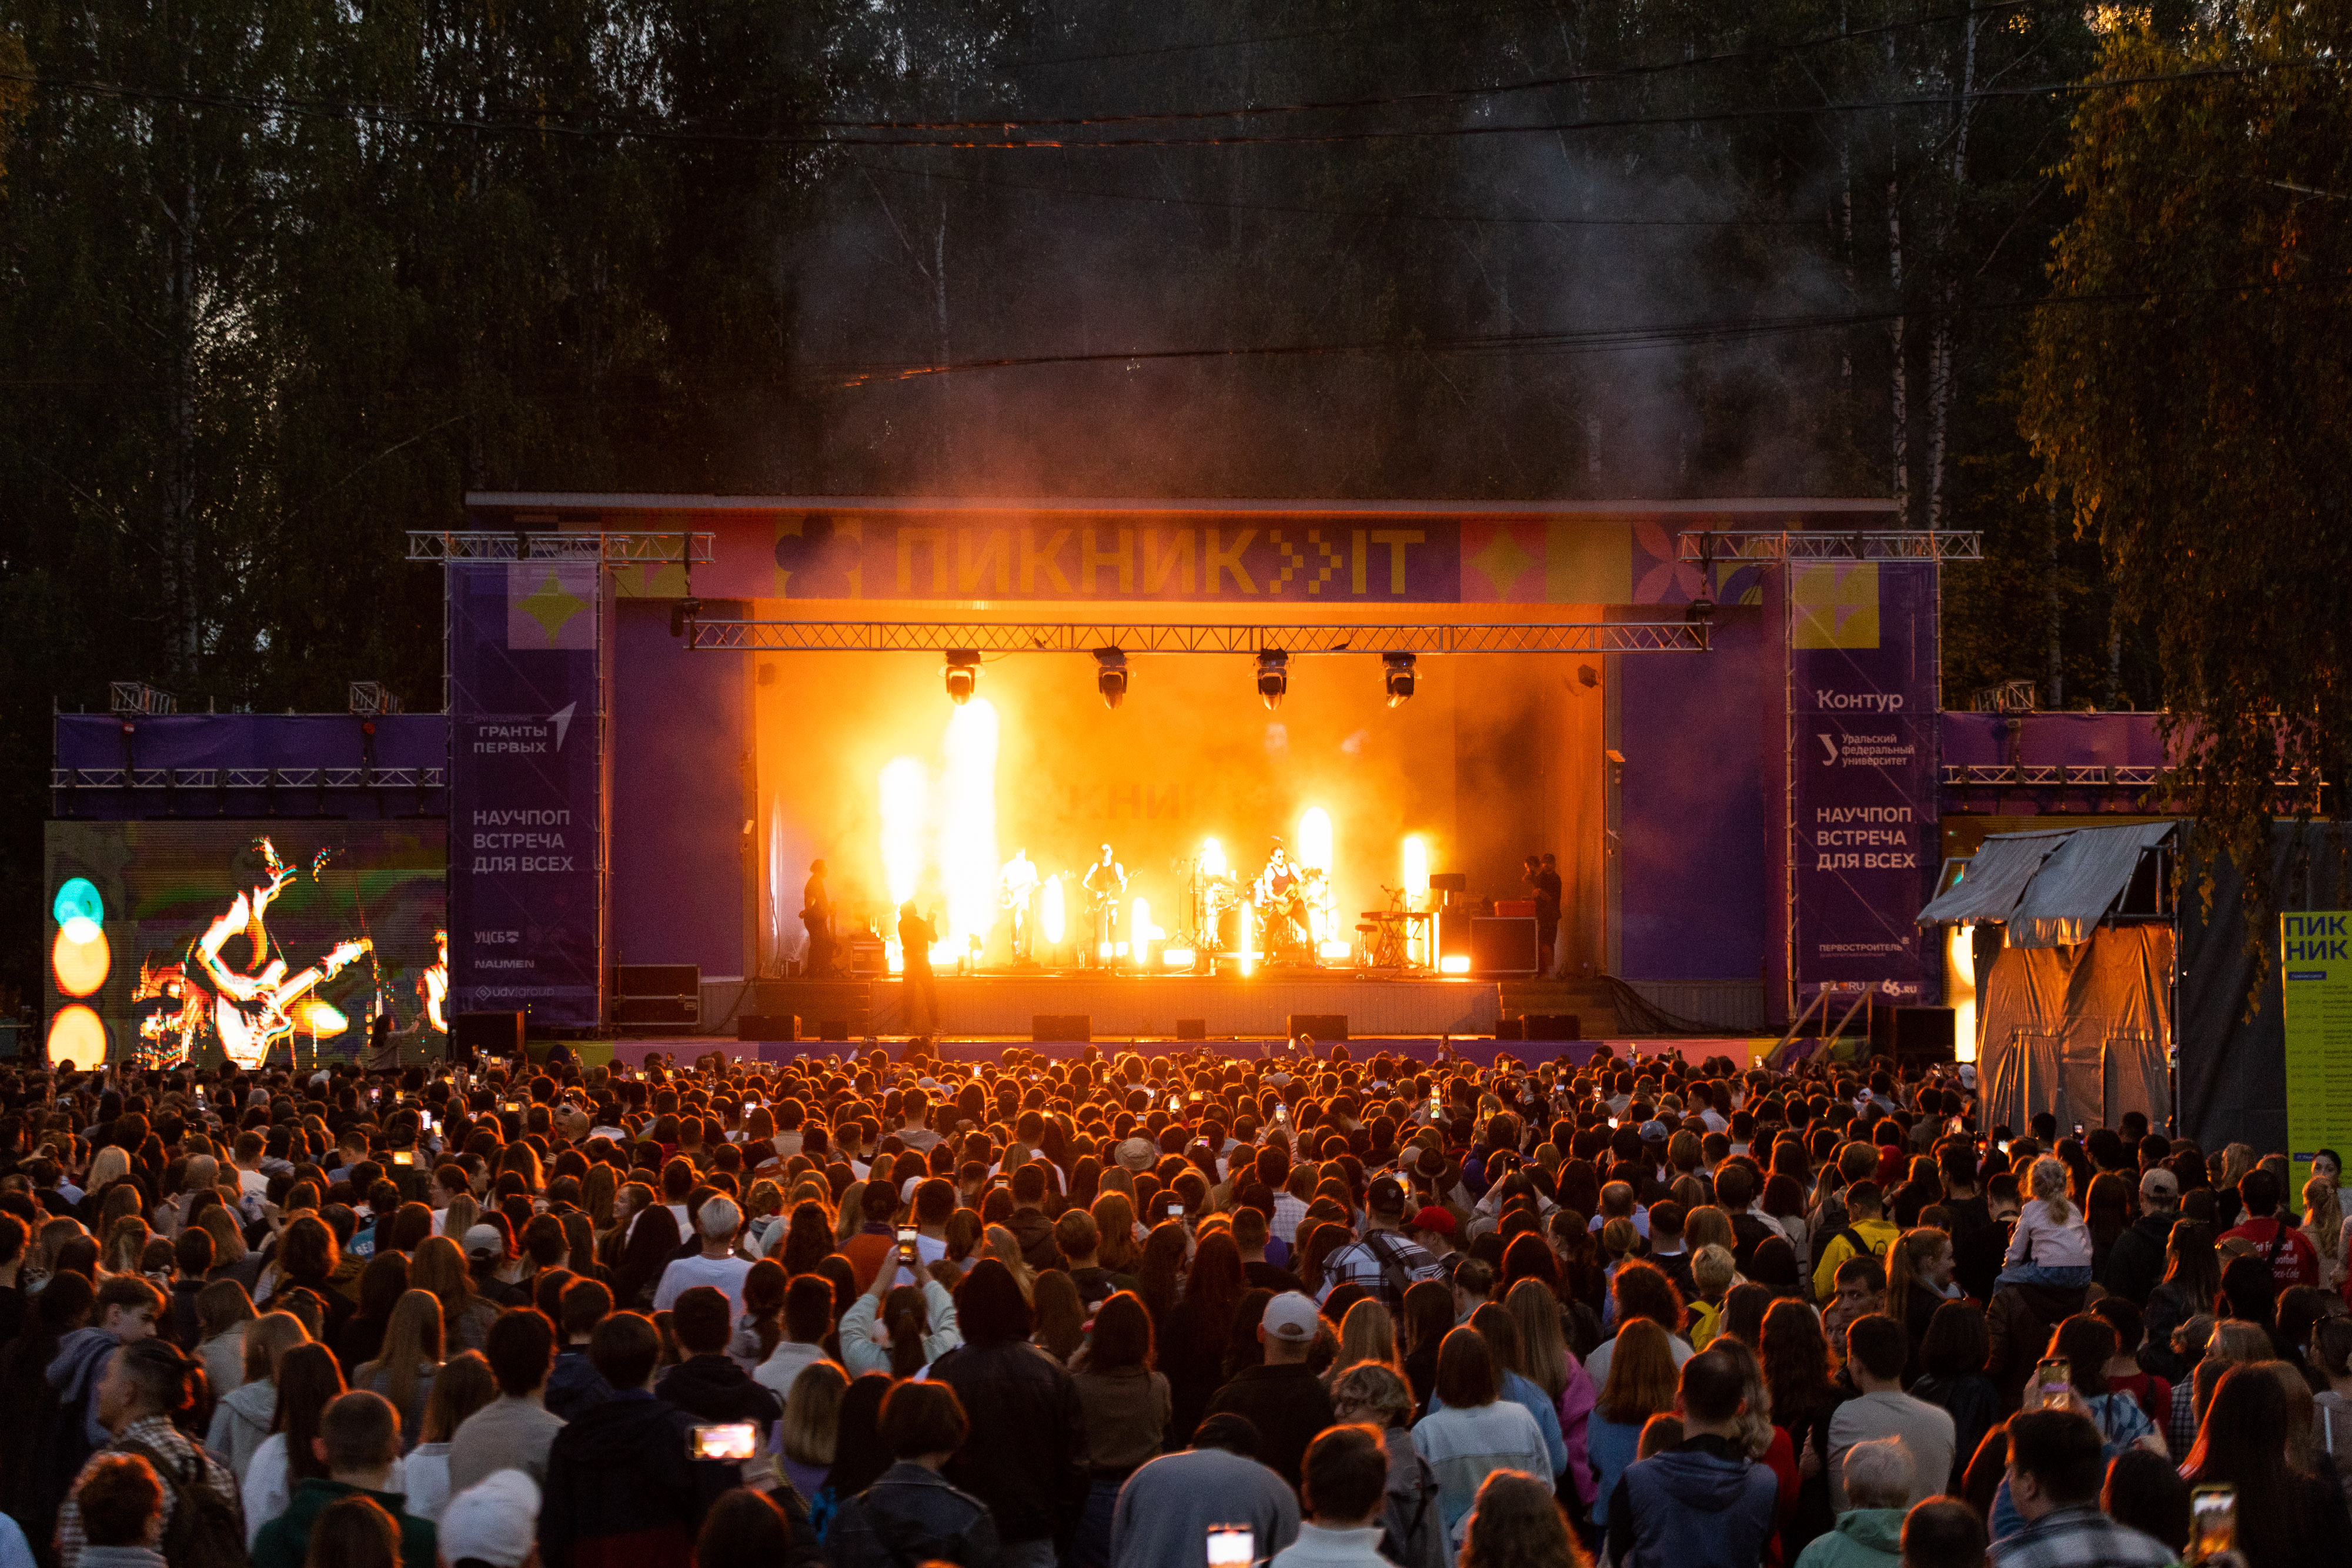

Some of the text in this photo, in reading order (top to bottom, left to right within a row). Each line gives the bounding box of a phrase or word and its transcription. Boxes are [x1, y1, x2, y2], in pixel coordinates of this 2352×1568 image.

[897, 527, 1425, 595] ПИКНИК IT
[1818, 690, 1903, 712] Контур
[479, 726, 548, 737] ГРАНТЫ
[1842, 734, 1897, 744] Уральский
[473, 742, 547, 753] ПЕРВЫХ
[1841, 744, 1915, 756] федеральный
[1842, 757, 1907, 768] университет
[473, 810, 570, 825] НАУЧПОП
[1817, 807, 1912, 823] НАУЧПОП
[473, 834, 565, 848] ВСТРЕЧА
[1817, 831, 1907, 846] ВСТРЕЧА
[472, 857, 574, 874] ДЛЯ ВСЕХ
[1816, 852, 1916, 871] ДЛЯ ВСЕХ
[2285, 915, 2348, 937] ПИК
[474, 931, 505, 945] УЦСБ
[1819, 943, 1903, 952] ПЕРВОСТРОИТЕЛЬ
[2286, 940, 2348, 961] НИК
[474, 959, 535, 969] NAUMEN
[1882, 978, 1917, 997] 66.RU
[2274, 1253, 2298, 1265] ootball
